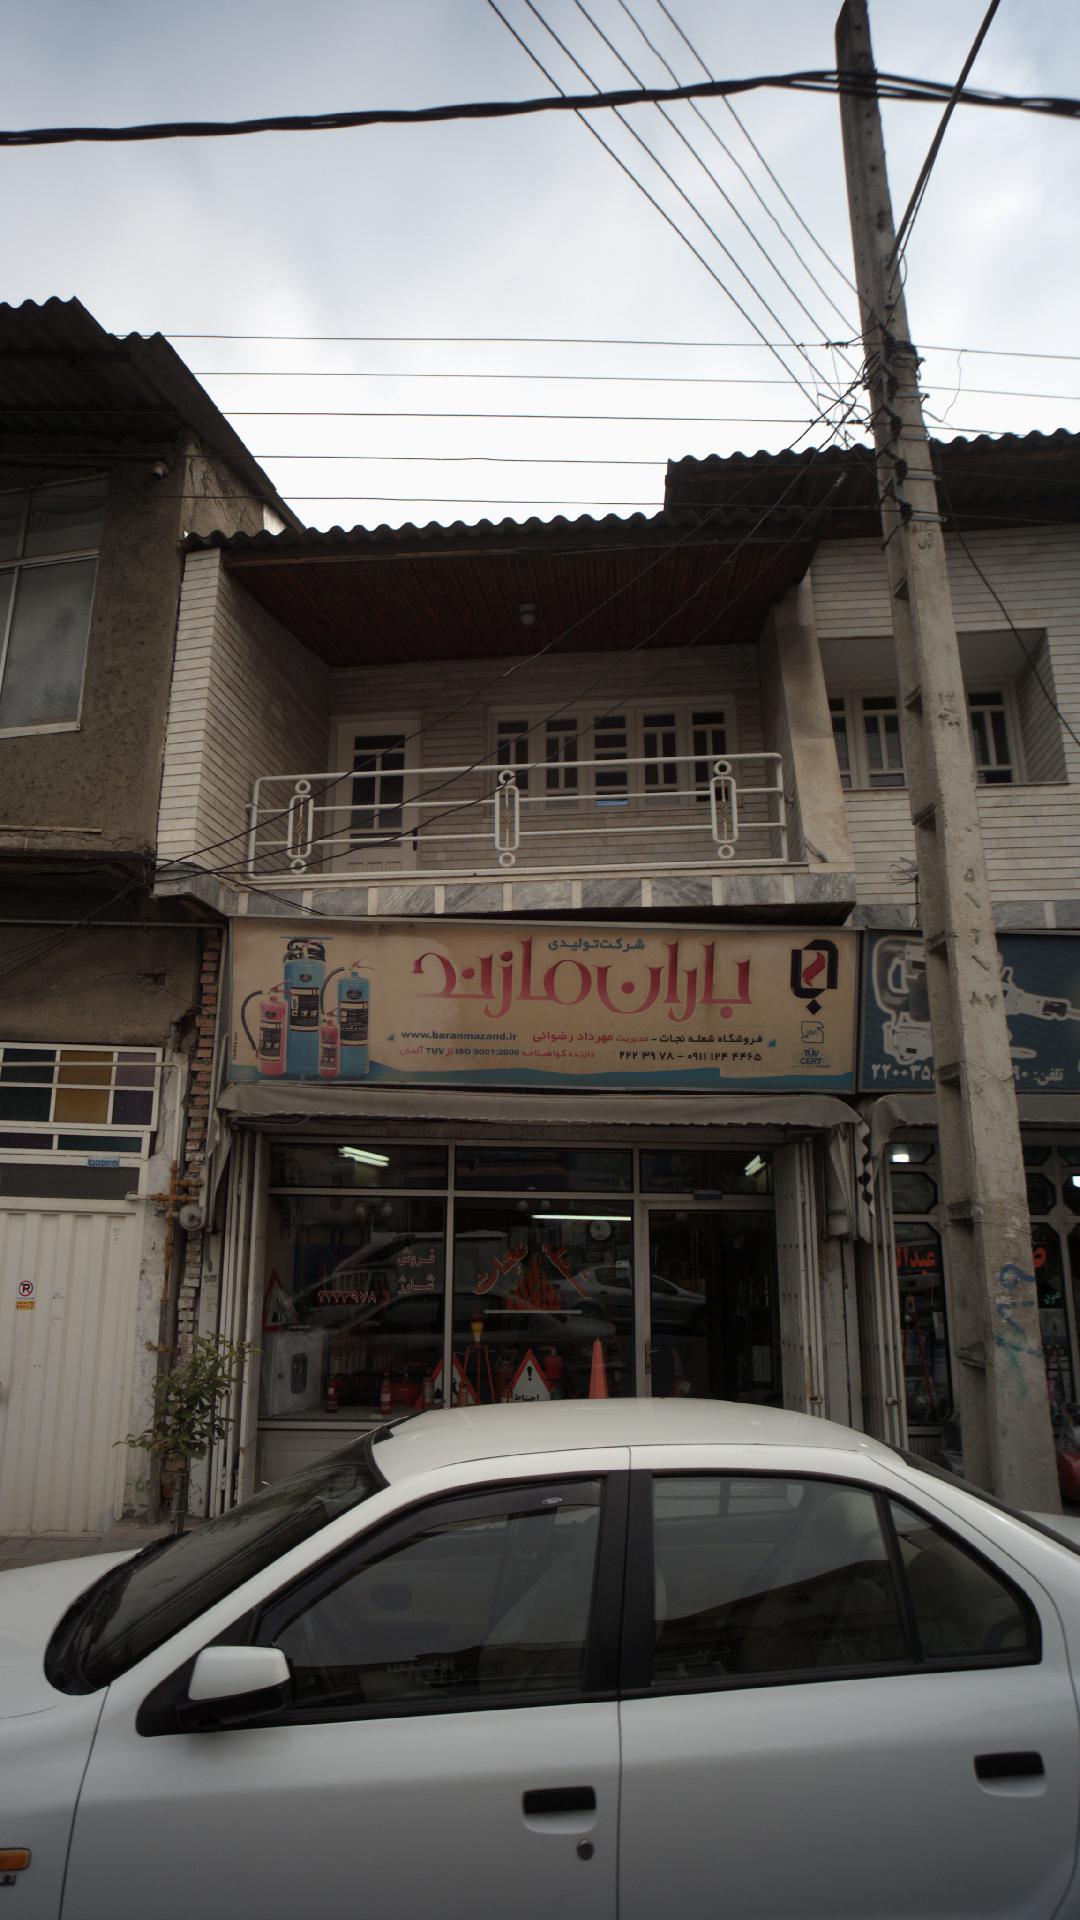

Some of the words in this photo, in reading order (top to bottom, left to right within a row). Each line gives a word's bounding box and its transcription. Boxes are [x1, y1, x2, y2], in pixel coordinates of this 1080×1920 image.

[411, 936, 593, 1019] مازند
[596, 940, 754, 1023] باران
[400, 1030, 518, 1041] www.baranmazand.ir
[576, 1032, 614, 1043] مهرداد
[659, 1034, 685, 1043] نجات
[688, 1034, 715, 1043] شعله
[717, 1034, 763, 1045] فروشگاه
[455, 1047, 471, 1056] ISO
[473, 1047, 520, 1056] 9001:2000
[659, 1051, 674, 1061] ۷۸
